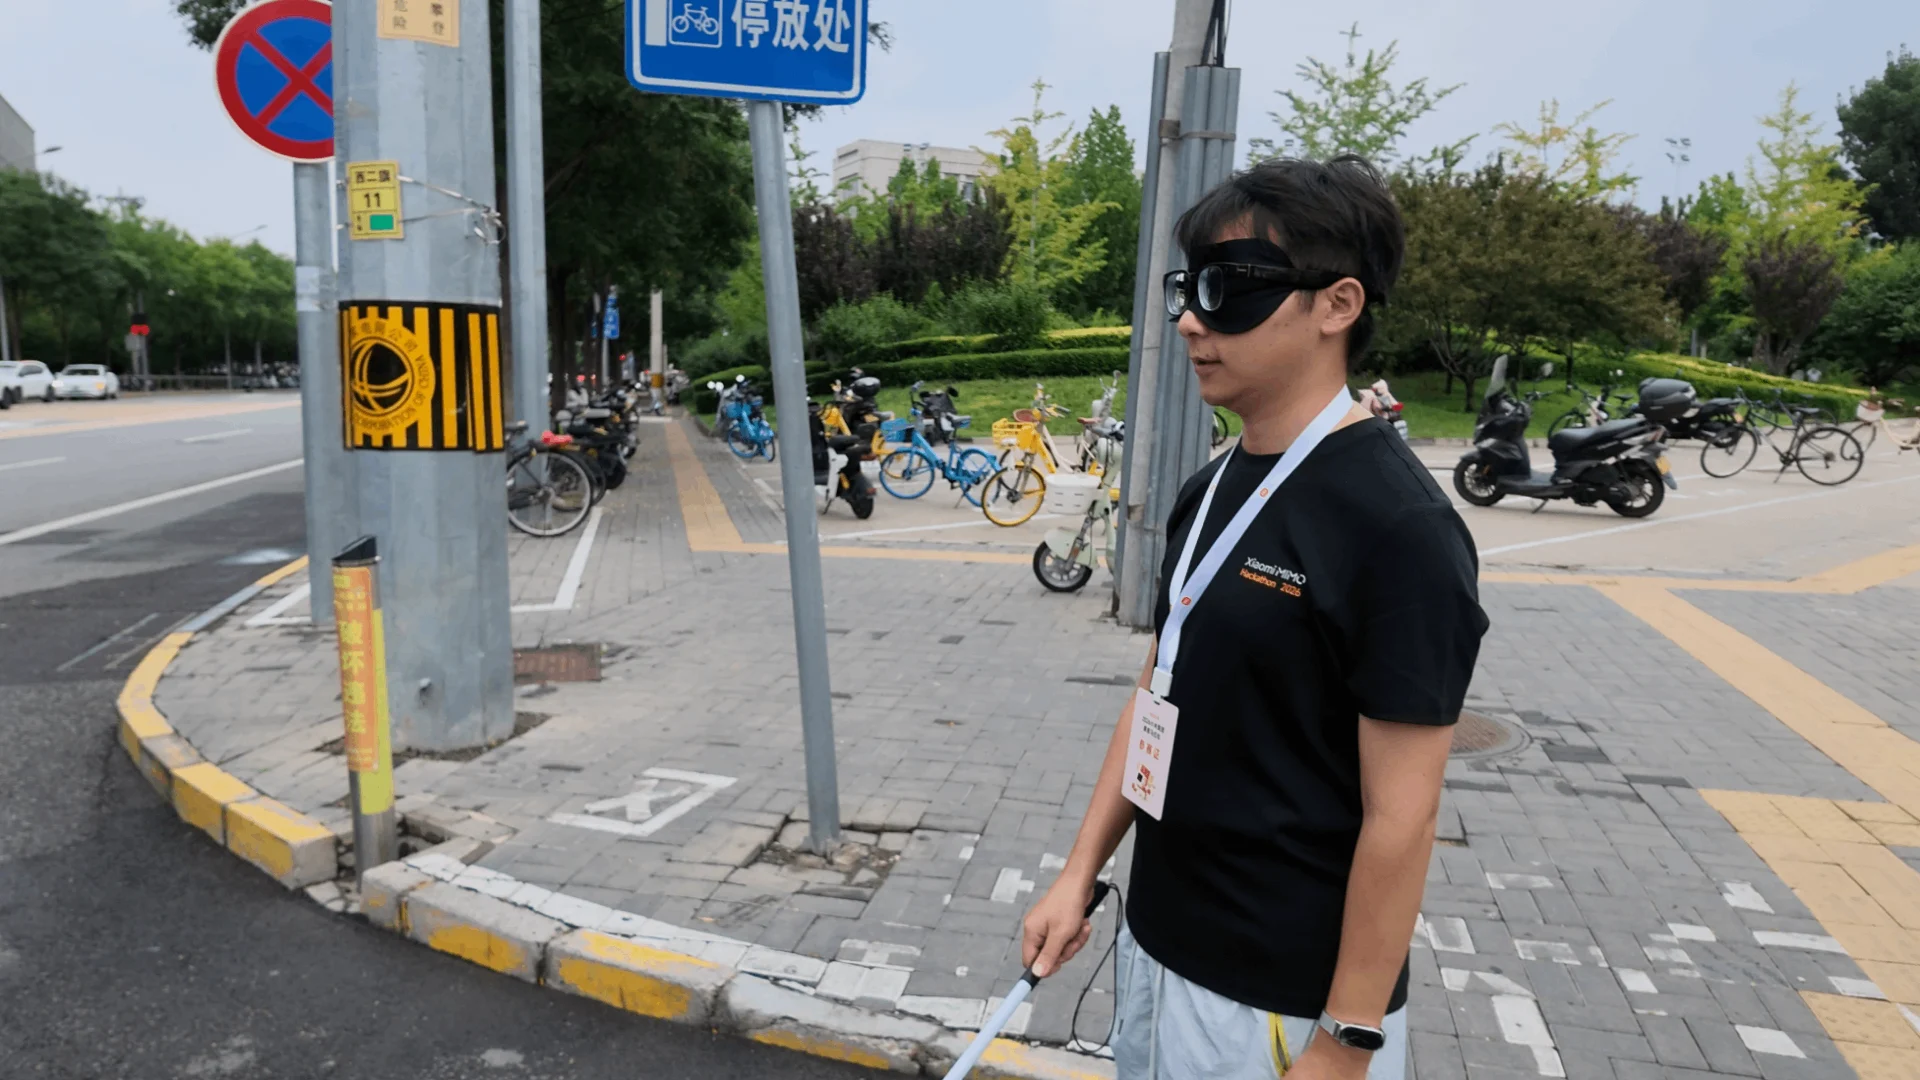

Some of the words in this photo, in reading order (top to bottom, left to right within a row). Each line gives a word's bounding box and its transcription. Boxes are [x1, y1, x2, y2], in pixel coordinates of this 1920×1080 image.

[731, 0, 851, 53] 停放处
[355, 170, 391, 184] 西二旗
[364, 192, 381, 208] 11
[1244, 557, 1277, 576] Xiaomi
[1240, 568, 1277, 588] Hackathon
[1280, 582, 1302, 597] 2026
